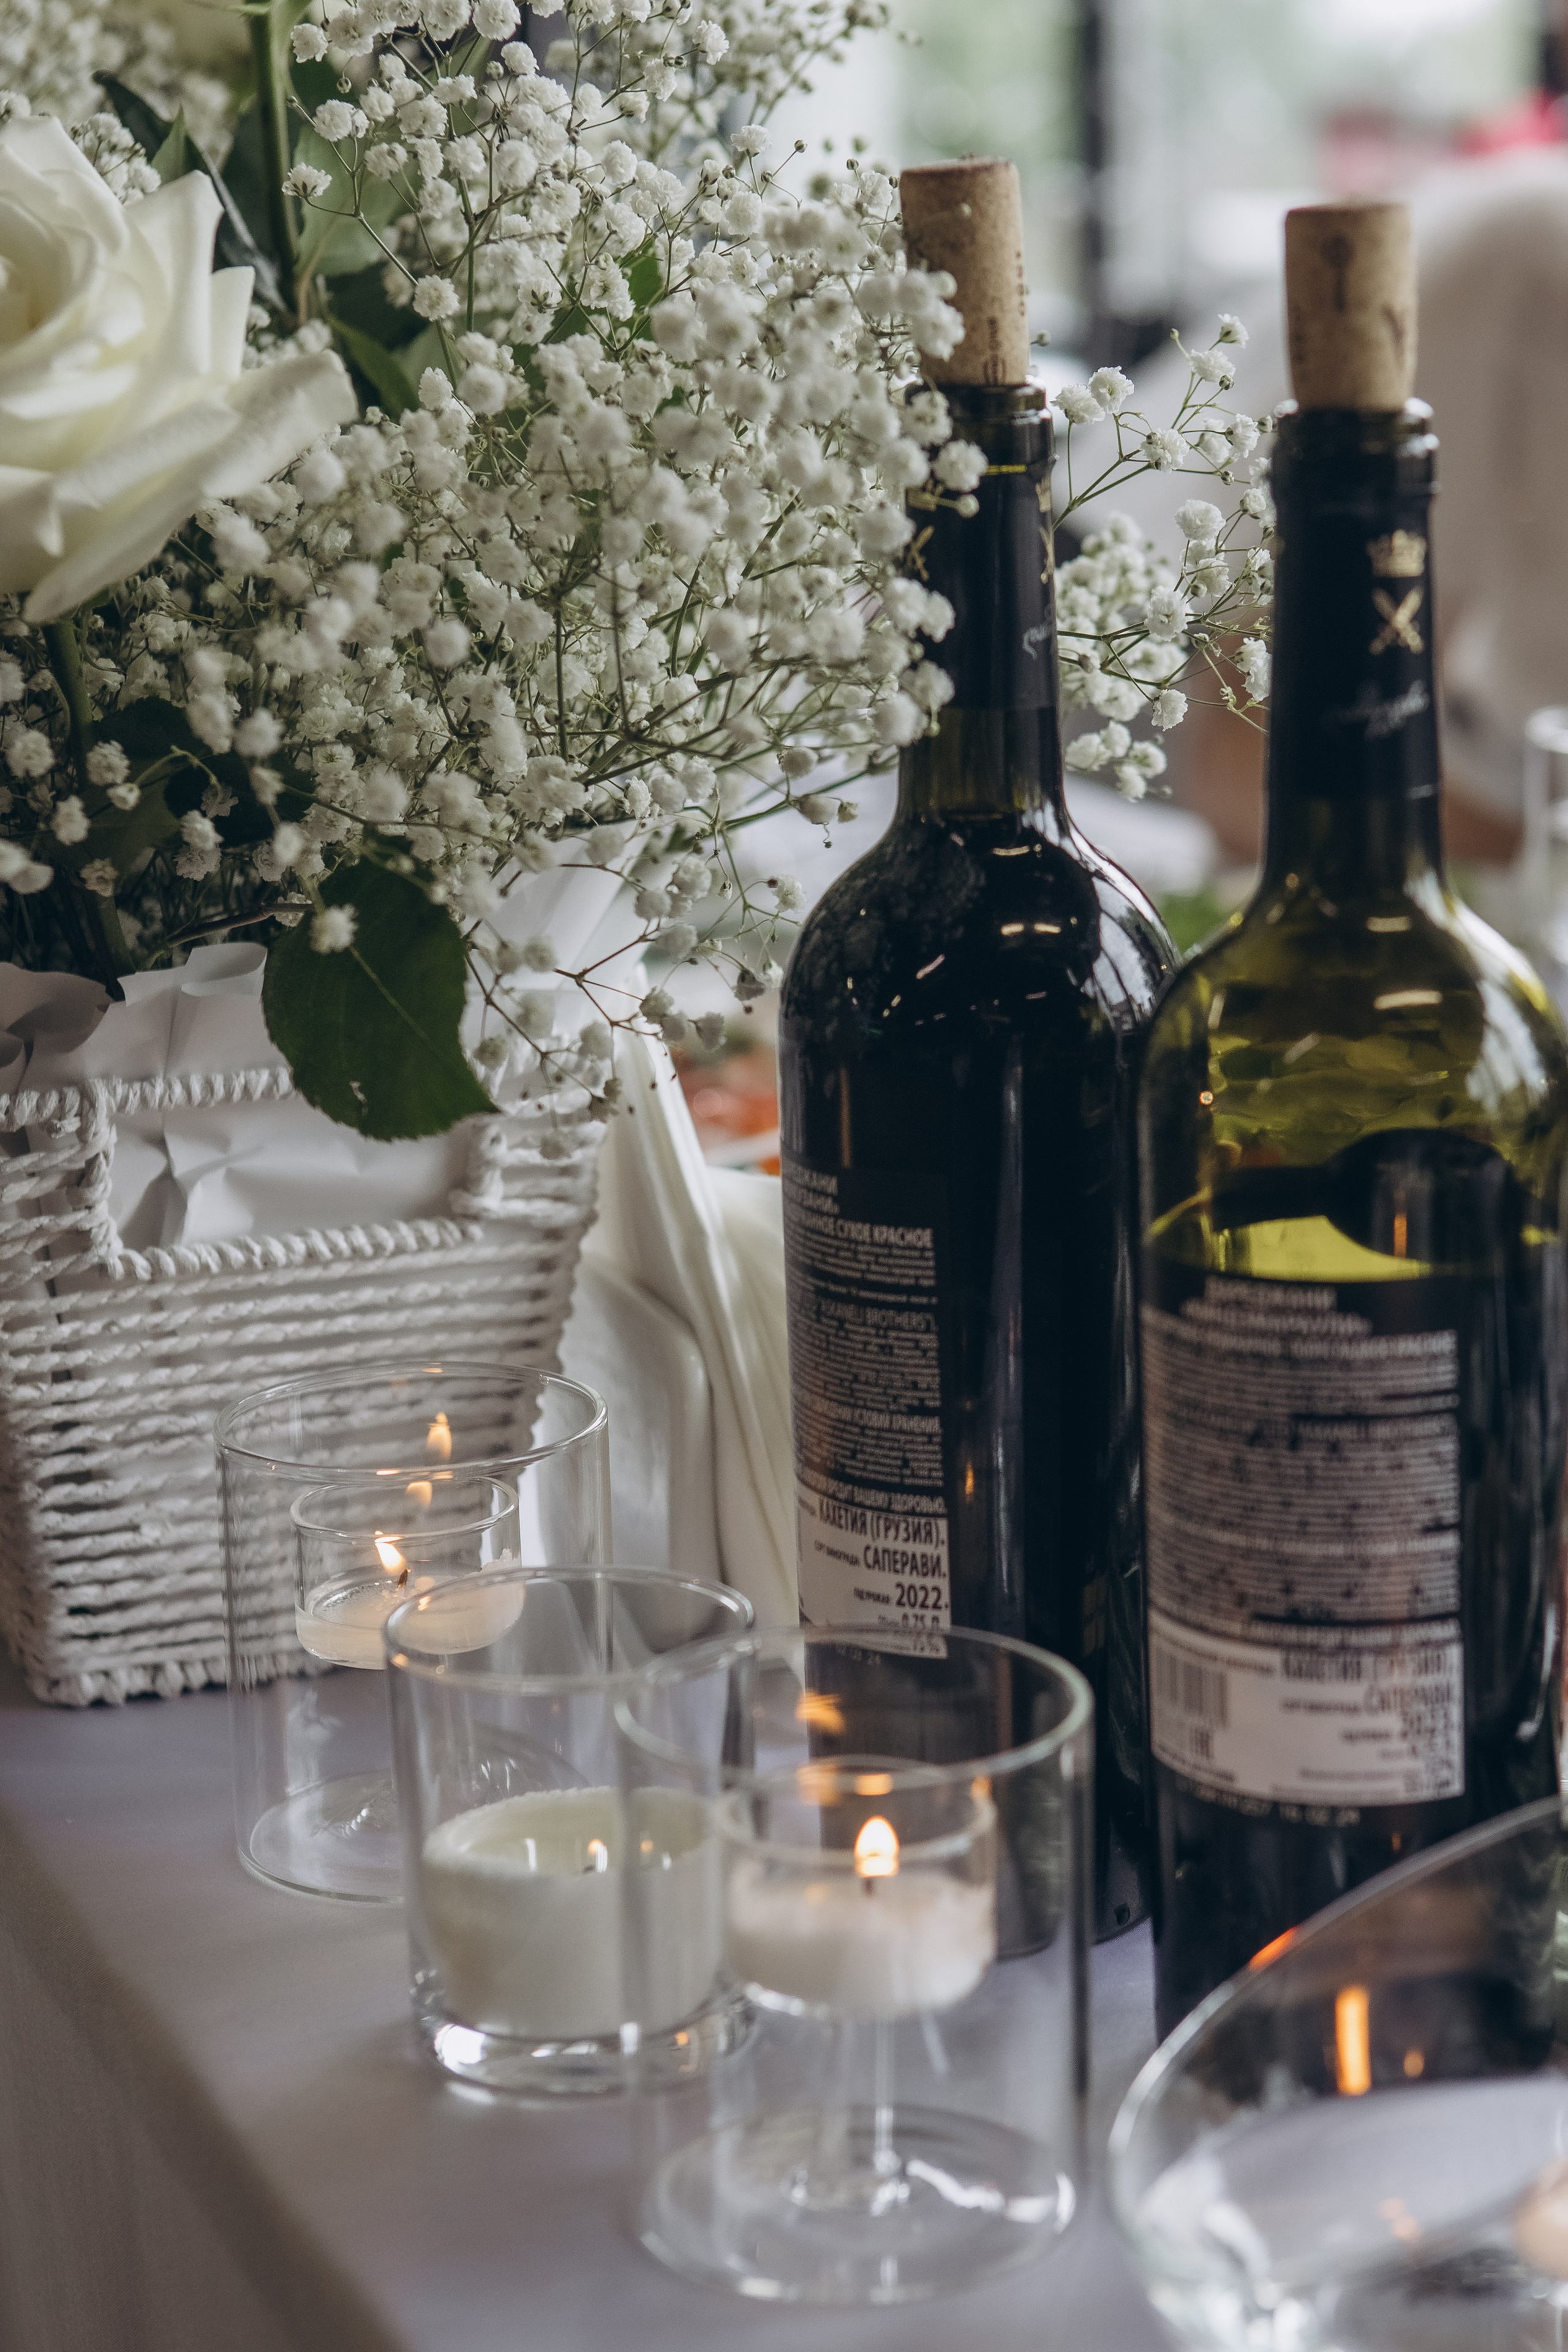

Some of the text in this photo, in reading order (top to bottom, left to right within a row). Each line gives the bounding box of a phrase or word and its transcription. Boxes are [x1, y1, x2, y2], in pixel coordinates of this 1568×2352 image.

[819, 1496, 867, 1537] КАХЕТИЯ
[870, 1510, 945, 1548] (ГРУЗИЯ).
[863, 1544, 947, 1577] САПЕРАВИ.
[895, 1581, 948, 1610] 2022.
